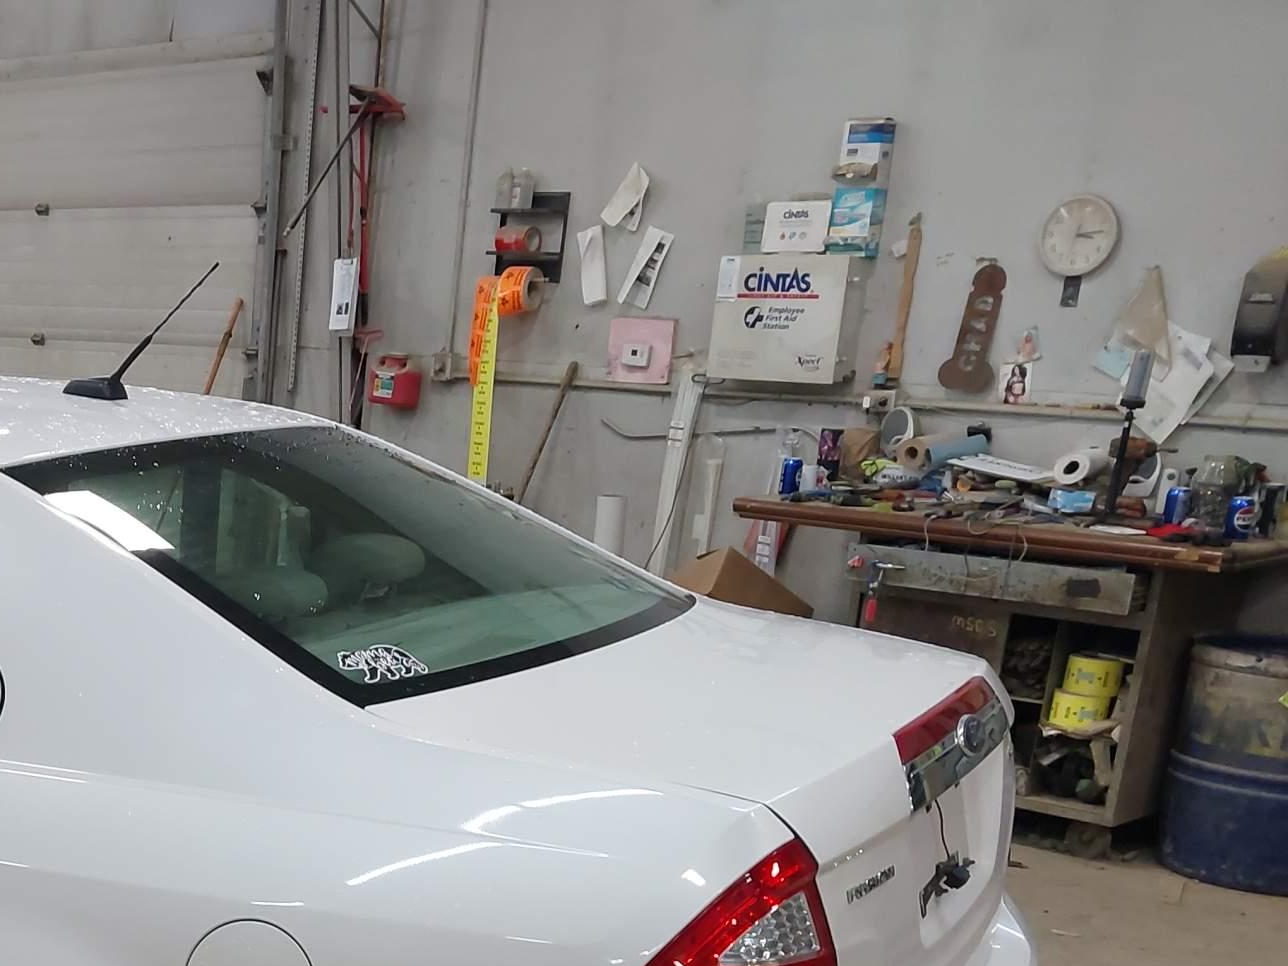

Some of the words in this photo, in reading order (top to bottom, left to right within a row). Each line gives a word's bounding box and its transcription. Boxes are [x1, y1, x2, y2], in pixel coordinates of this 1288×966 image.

[744, 266, 812, 292] CINTAS
[765, 313, 783, 321] First
[768, 306, 805, 317] Employee
